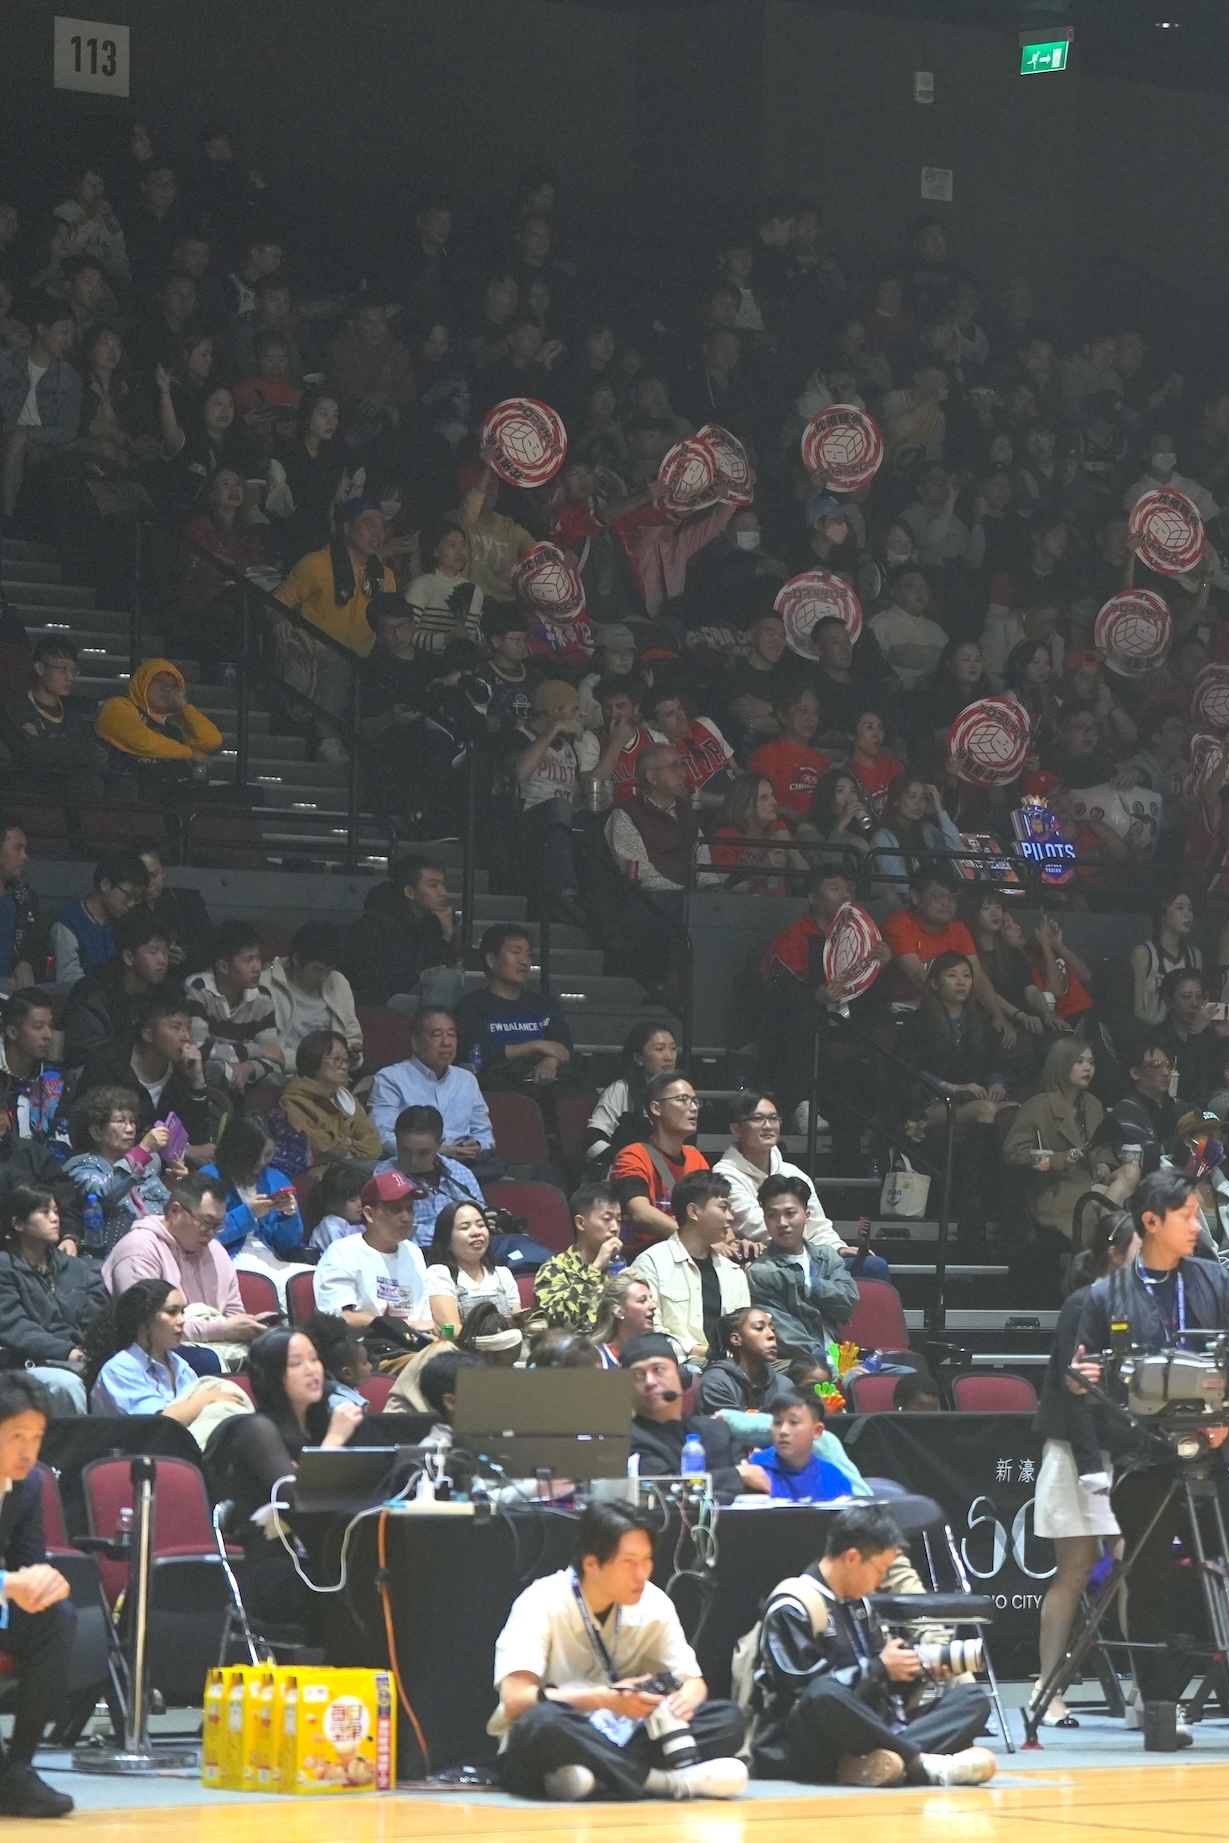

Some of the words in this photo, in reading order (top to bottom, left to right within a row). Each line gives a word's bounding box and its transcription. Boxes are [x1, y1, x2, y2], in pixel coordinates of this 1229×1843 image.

[71, 35, 117, 77] 113
[1021, 841, 1076, 860] PILOTS
[503, 1021, 539, 1031] BALANCE
[995, 1458, 1036, 1484] 新濠
[1011, 1594, 1043, 1610] CITY
